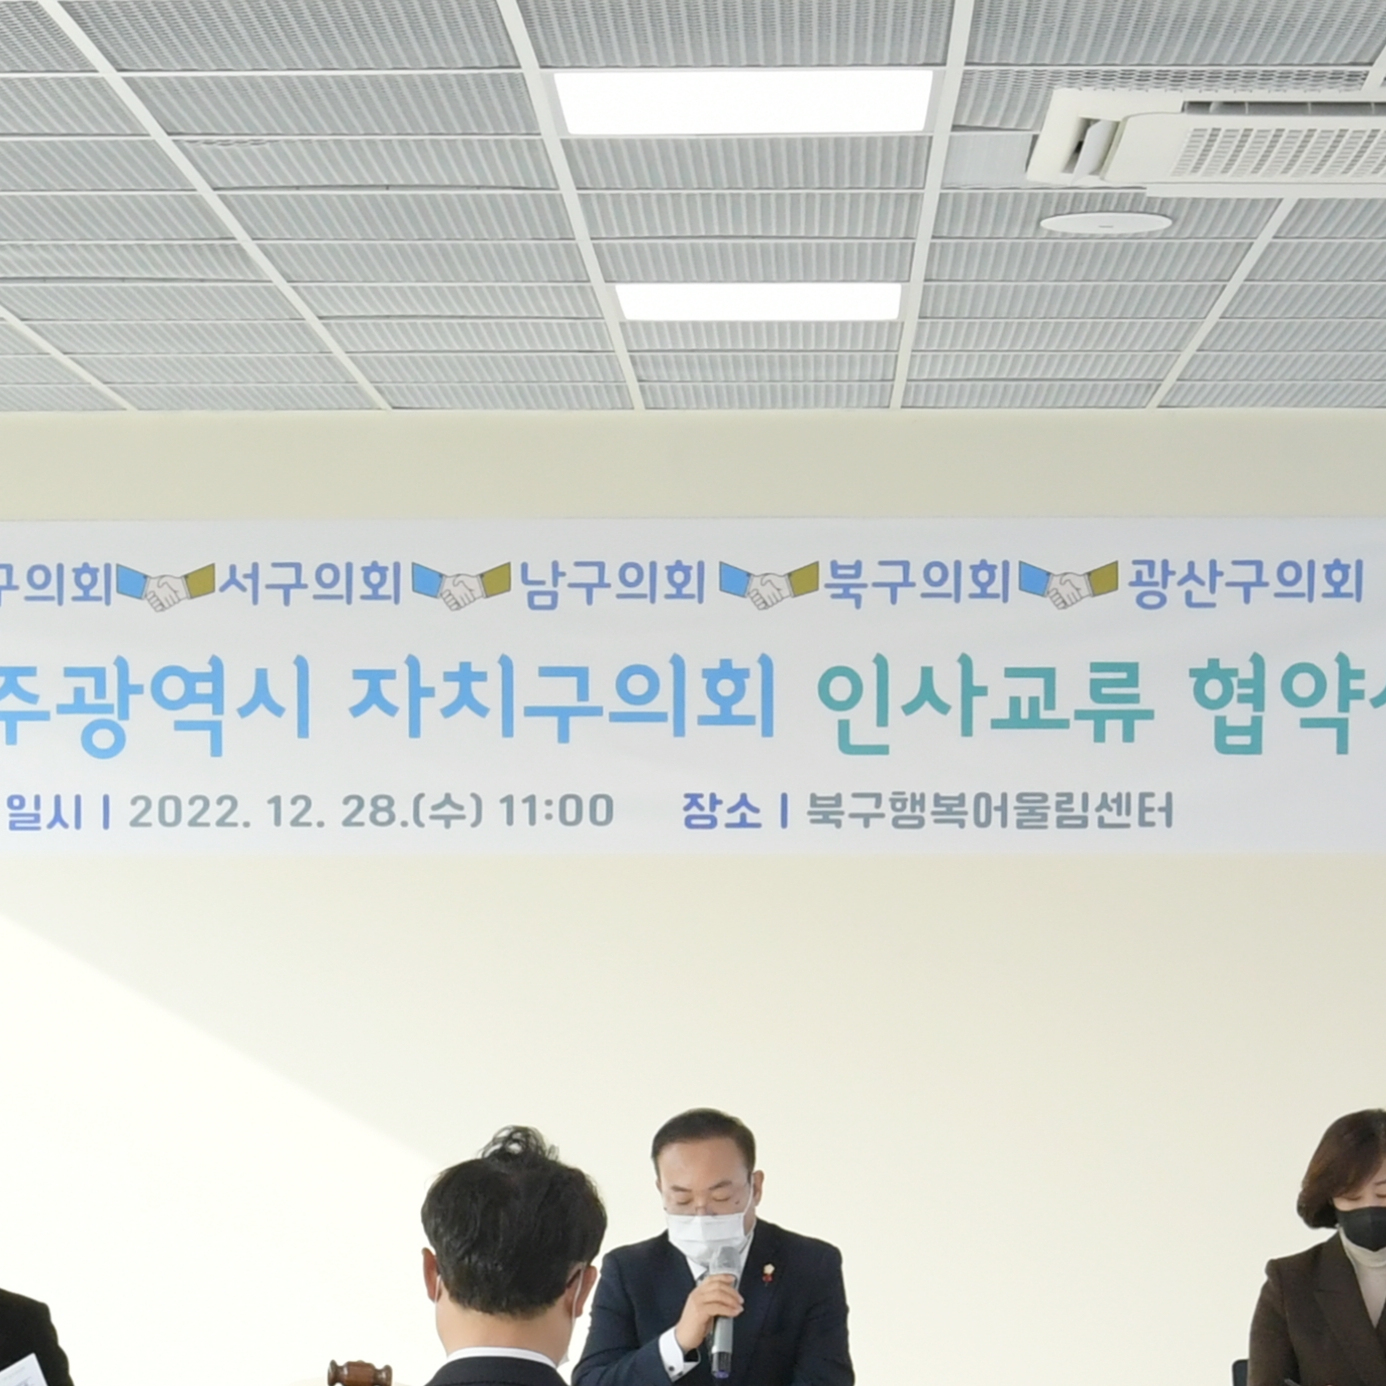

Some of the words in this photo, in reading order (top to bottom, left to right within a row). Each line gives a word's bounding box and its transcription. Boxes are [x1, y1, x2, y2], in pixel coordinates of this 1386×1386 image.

[218, 560, 402, 607] 서구의회
[521, 560, 705, 610] 남구의회
[824, 558, 1010, 609] 북구의회
[1128, 558, 1364, 610] 광산구의회
[349, 652, 774, 745] 자치구의회
[817, 652, 1155, 756] 인사교류
[129, 795, 250, 828] 2022.
[267, 794, 325, 828] 12.
[342, 792, 483, 830] 28.(수)
[499, 793, 614, 828] 11:00
[806, 791, 1174, 830] 북구행복어울림센터
